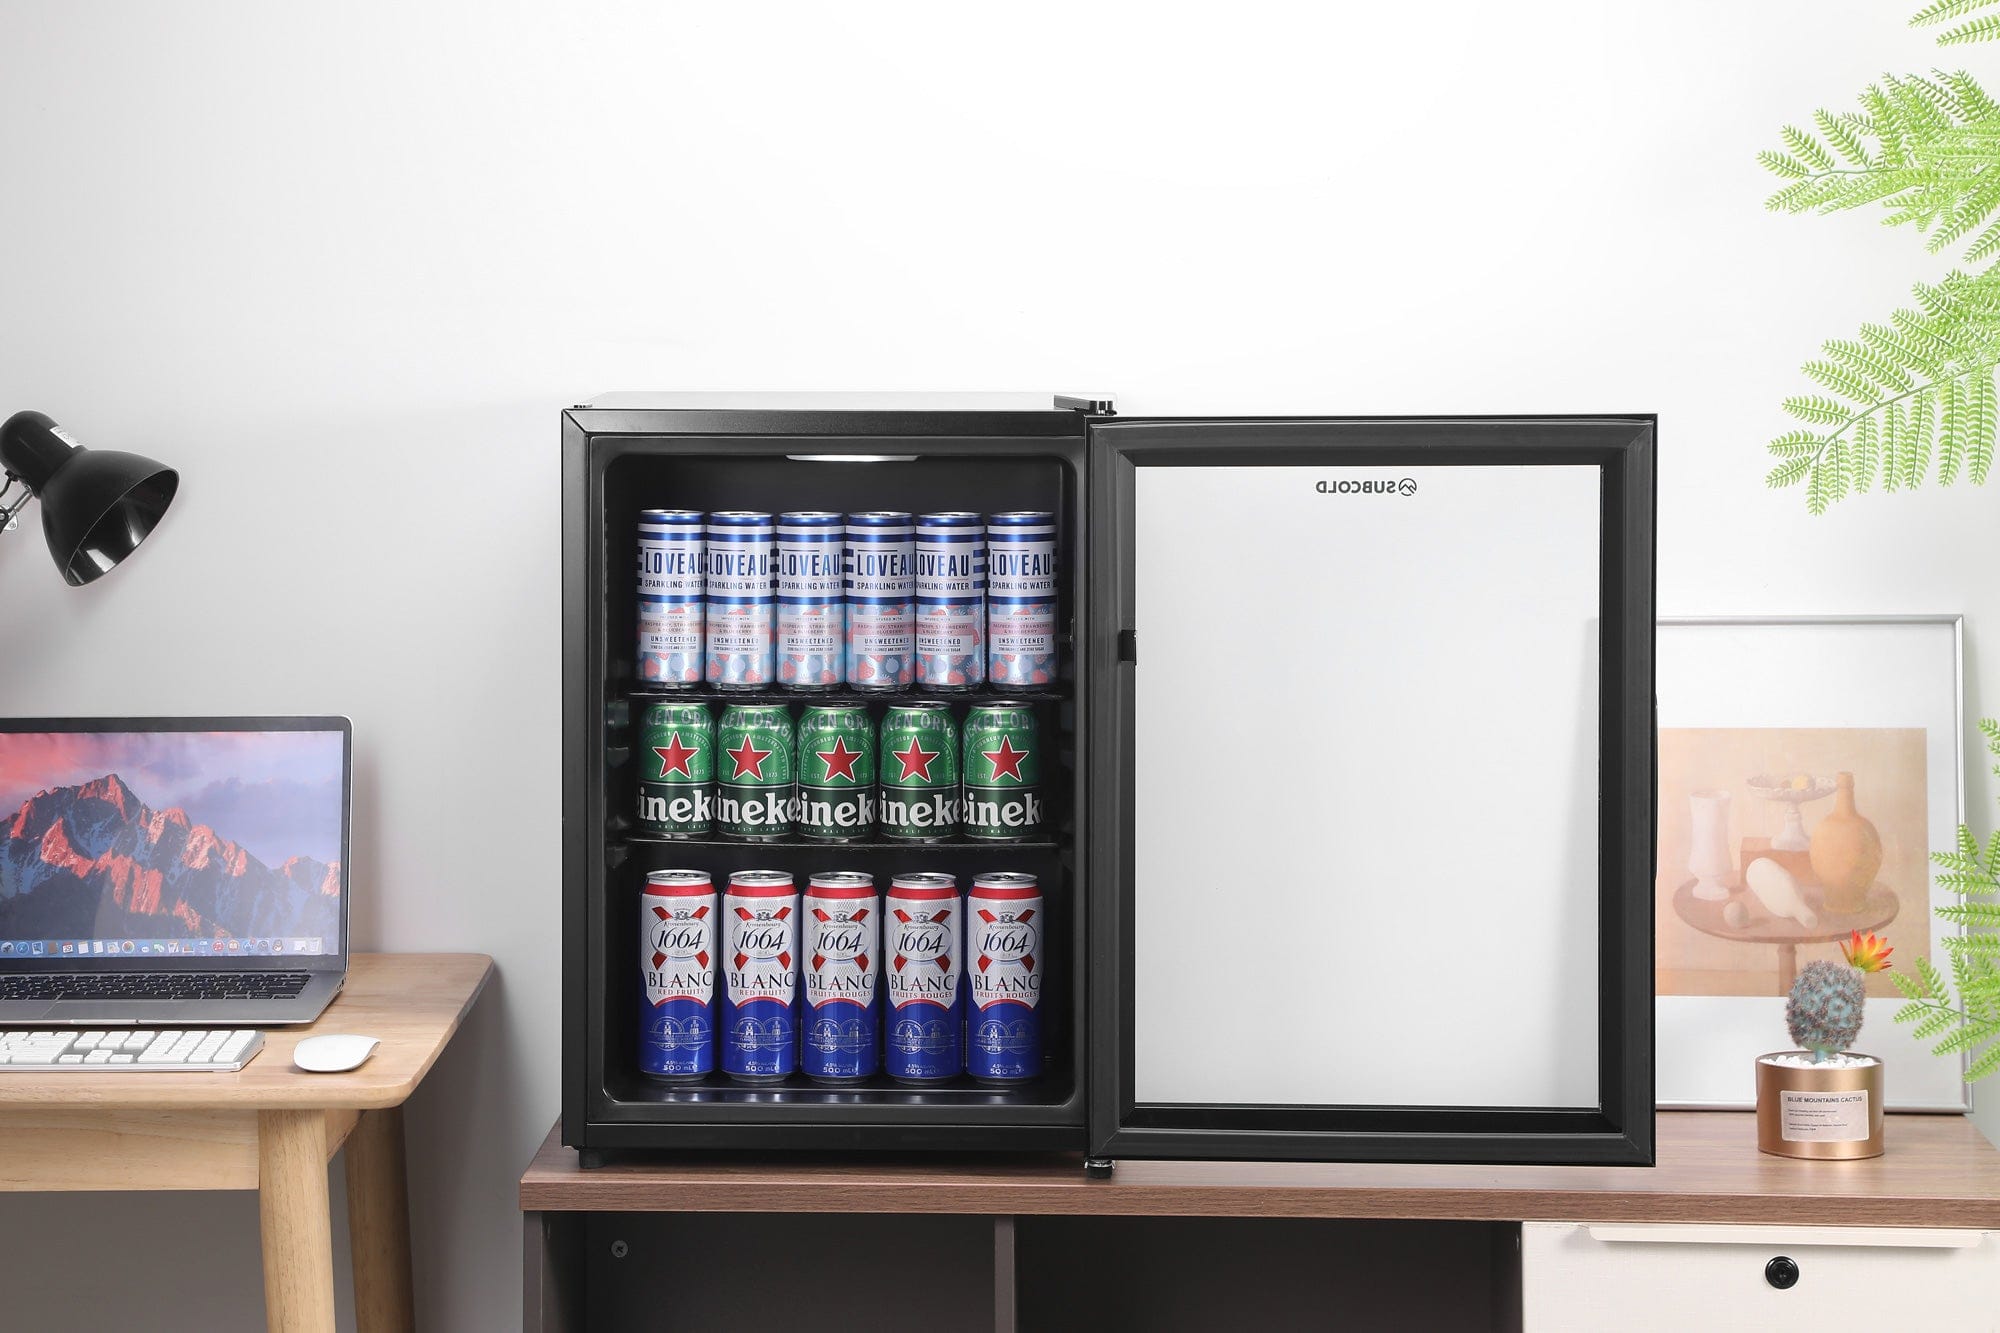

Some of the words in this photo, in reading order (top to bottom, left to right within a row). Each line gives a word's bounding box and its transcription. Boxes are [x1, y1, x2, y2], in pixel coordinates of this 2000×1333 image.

[645, 551, 704, 575] LOVEAU
[709, 553, 767, 576] LOVEAU
[781, 553, 840, 577] LOVEAU
[857, 553, 914, 577] LOVEAU
[992, 553, 1050, 576] LOVEAU
[645, 579, 683, 589] SPARKLING
[685, 580, 704, 588] WATER
[709, 581, 743, 590] SPARKLING
[744, 581, 767, 589] WATER
[781, 581, 818, 590] SPARKLING
[820, 581, 840, 590] WATER
[857, 582, 896, 590] SPARKLING
[945, 582, 970, 591] WATER
[992, 581, 1028, 590] SPARKLING
[1029, 581, 1051, 590] WATER
[657, 927, 704, 950] 1664
[739, 927, 786, 950] 1664
[817, 929, 864, 952] 1664
[898, 930, 945, 953] 1664
[983, 930, 1030, 953] 1664
[648, 971, 713, 988] BLANC
[730, 971, 794, 989] BLANC
[808, 973, 873, 990] BLANC
[890, 974, 955, 992] BLANC
[974, 974, 1038, 992] BLANC
[892, 990, 918, 998] FRUITS
[920, 991, 953, 999] ROUGES
[976, 990, 1003, 998] FRUITS
